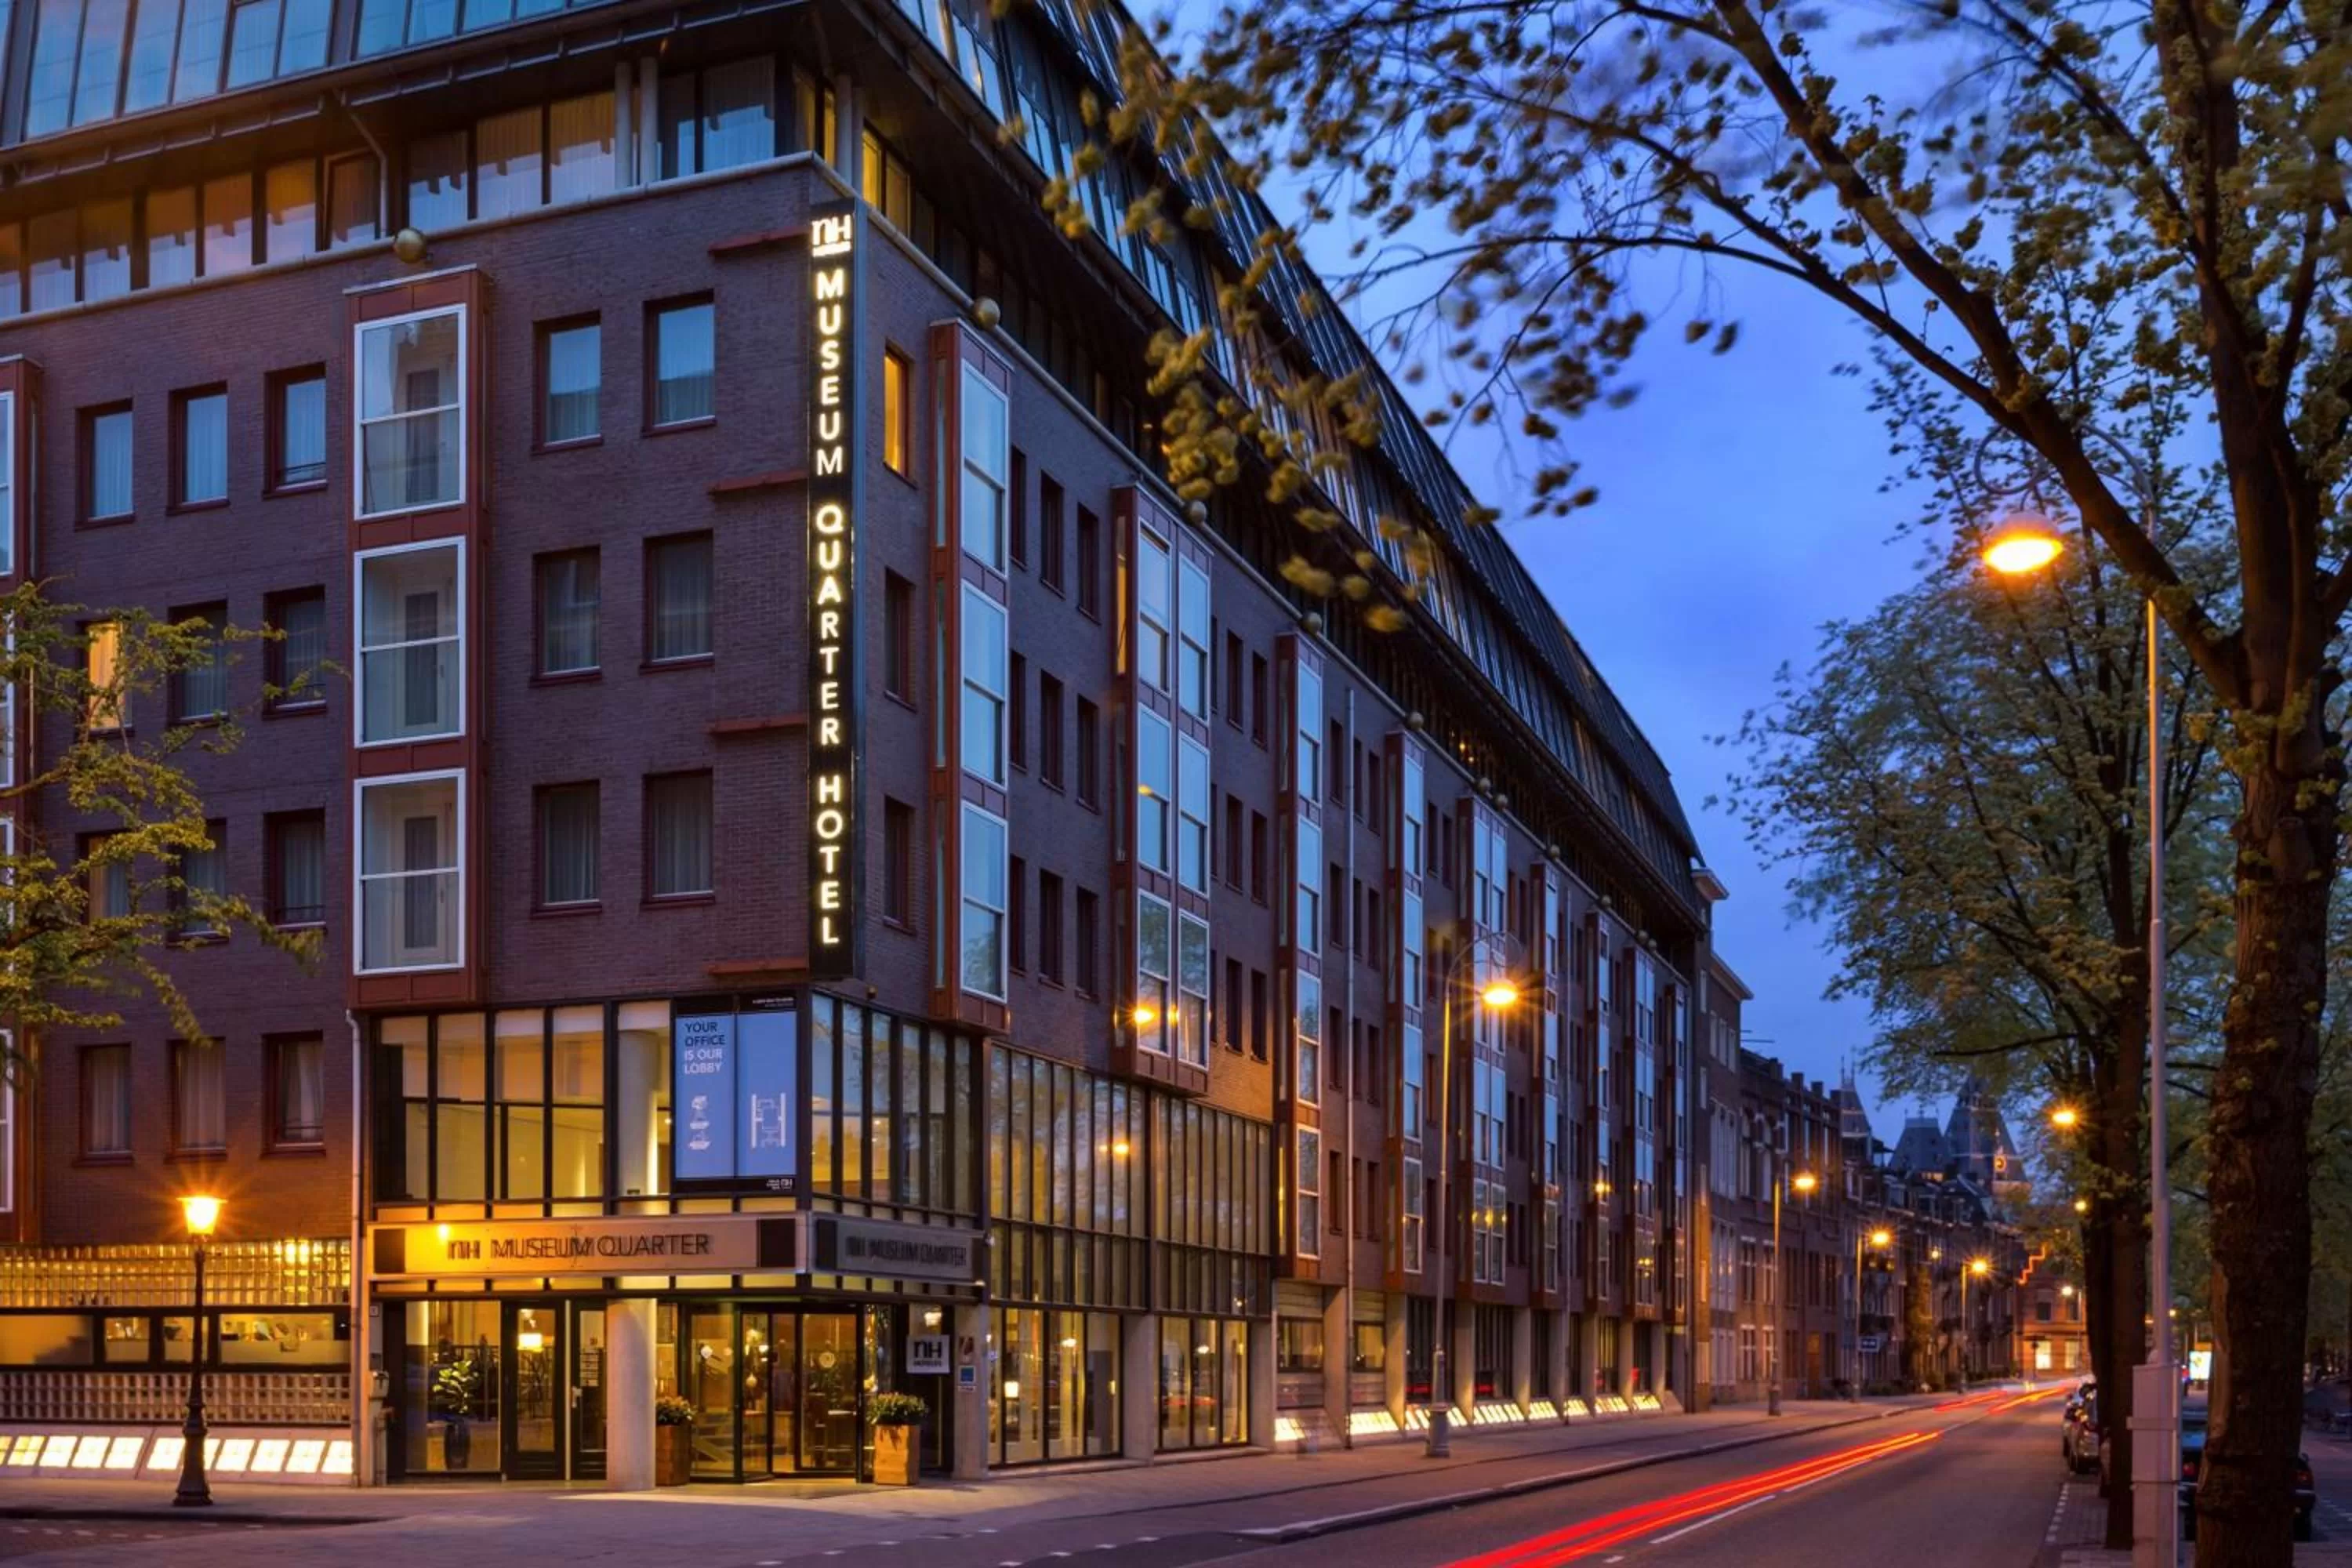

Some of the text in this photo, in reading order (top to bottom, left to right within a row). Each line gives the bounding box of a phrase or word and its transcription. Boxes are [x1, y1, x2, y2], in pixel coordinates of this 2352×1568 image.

[815, 269, 844, 476] MUSEUM
[815, 505, 843, 747] QUARTER
[816, 775, 843, 945] HOTEL
[684, 1022, 718, 1033] YOUR
[684, 1034, 725, 1047] OFFICE
[684, 1048, 722, 1060] IS OUR
[684, 1062, 722, 1074] LOBBY
[491, 1236, 594, 1258] MUSEUM
[597, 1233, 712, 1257] QUARTER
